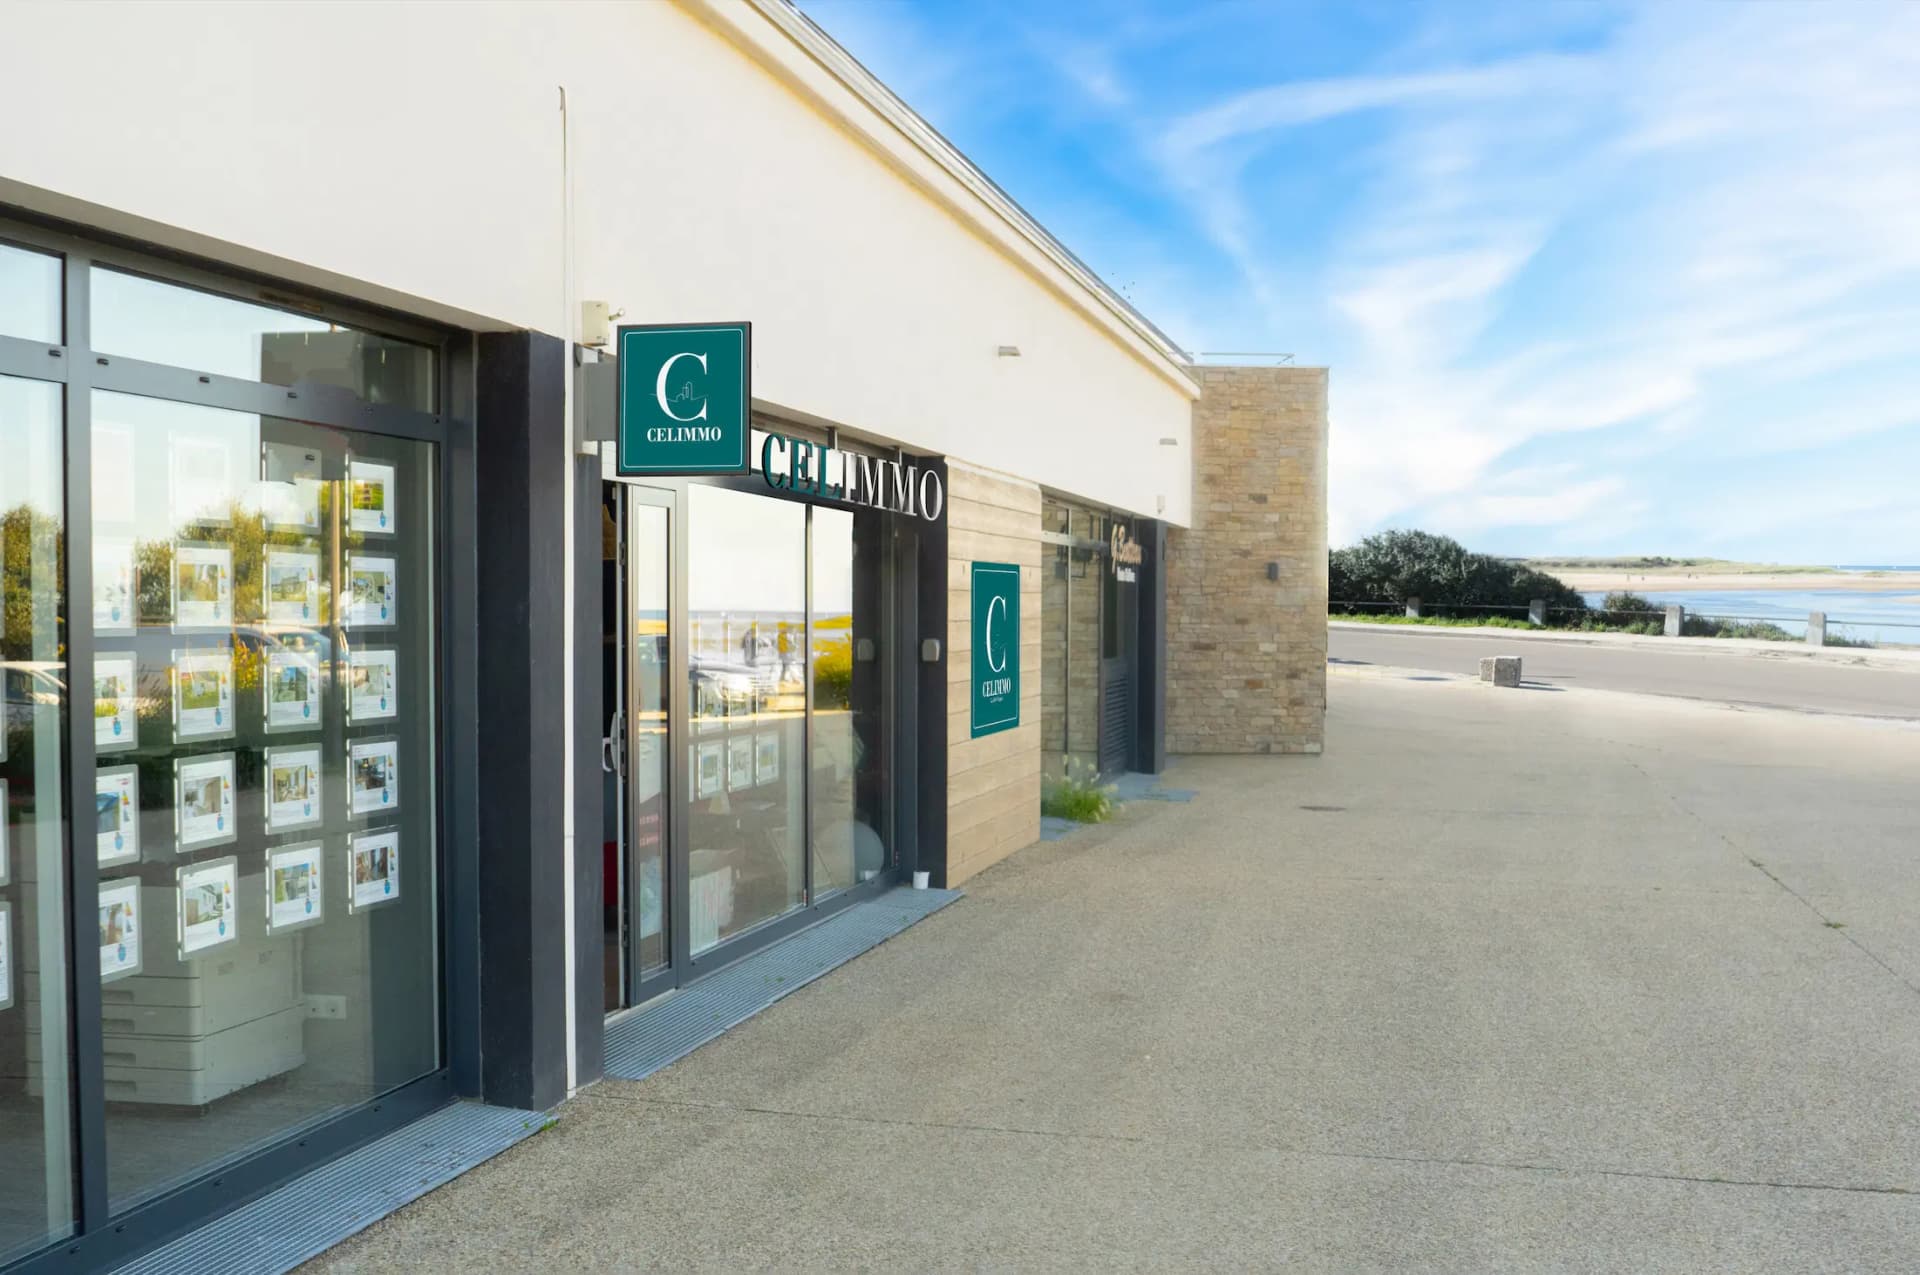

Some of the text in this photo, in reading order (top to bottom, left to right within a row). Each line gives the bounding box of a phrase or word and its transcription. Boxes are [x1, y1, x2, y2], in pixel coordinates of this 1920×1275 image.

[656, 352, 707, 421] C
[647, 426, 721, 442] CELIMMO
[762, 433, 943, 520] CELIMMO
[986, 596, 1006, 673] C
